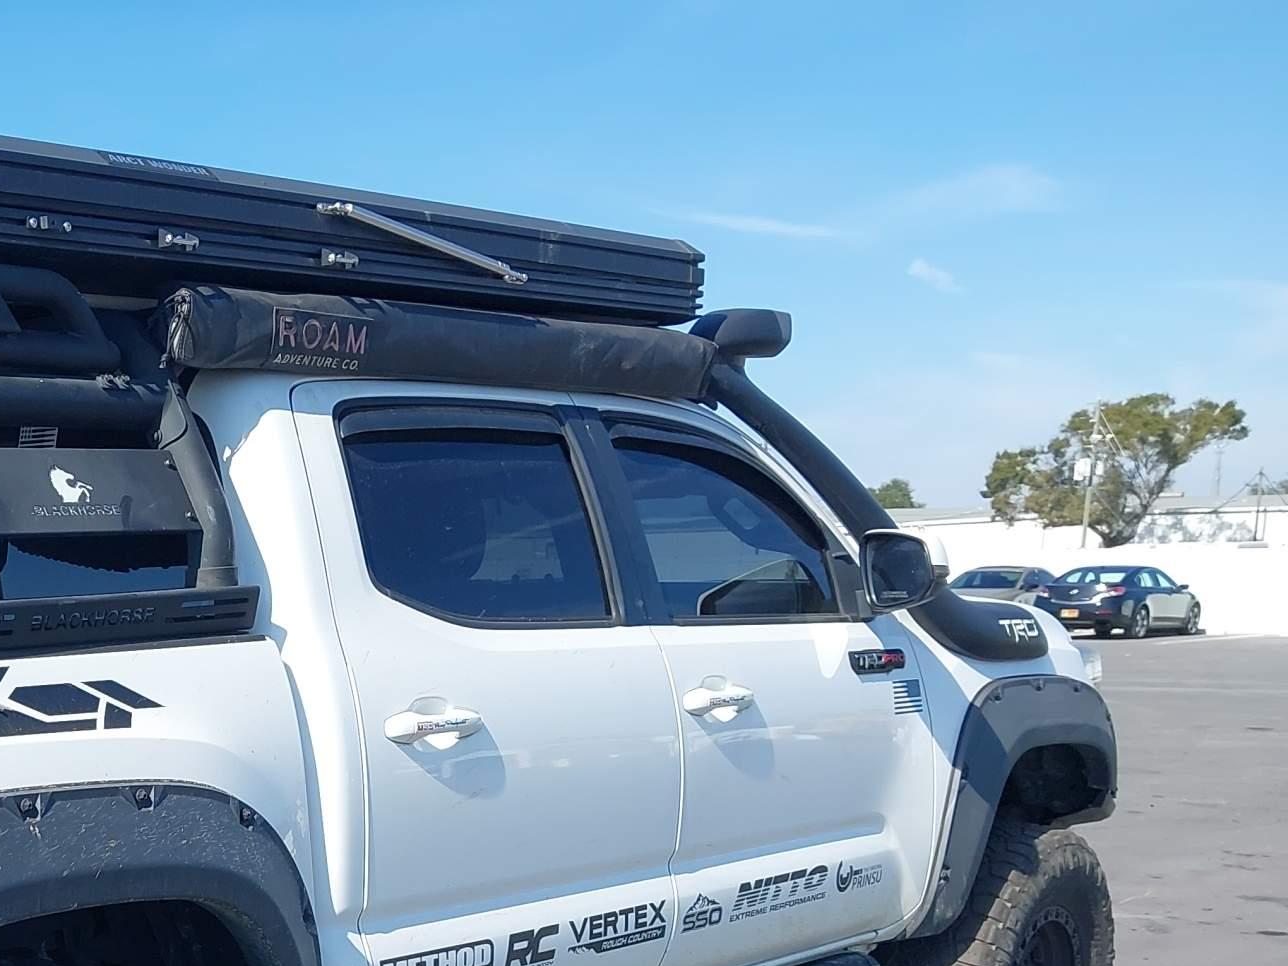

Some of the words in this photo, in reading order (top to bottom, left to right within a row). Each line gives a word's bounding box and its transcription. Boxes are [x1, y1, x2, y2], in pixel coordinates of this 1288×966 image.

[108, 153, 145, 166] ARCT
[278, 315, 368, 355] ROAM
[272, 353, 340, 369] ADVENTURE
[341, 359, 359, 371] CO.
[32, 505, 121, 517] BLACKHORSE
[31, 607, 155, 632] BLACKHORSE
[998, 618, 1039, 643] TRD
[731, 864, 830, 912] NITTO
[851, 869, 883, 890] PRINSU
[728, 906, 768, 923] EXTREME
[769, 891, 829, 913] PERFORMANCE
[569, 899, 666, 944] VERTEX
[601, 937, 627, 951] ROUGH
[627, 929, 663, 945] COUNTRY
